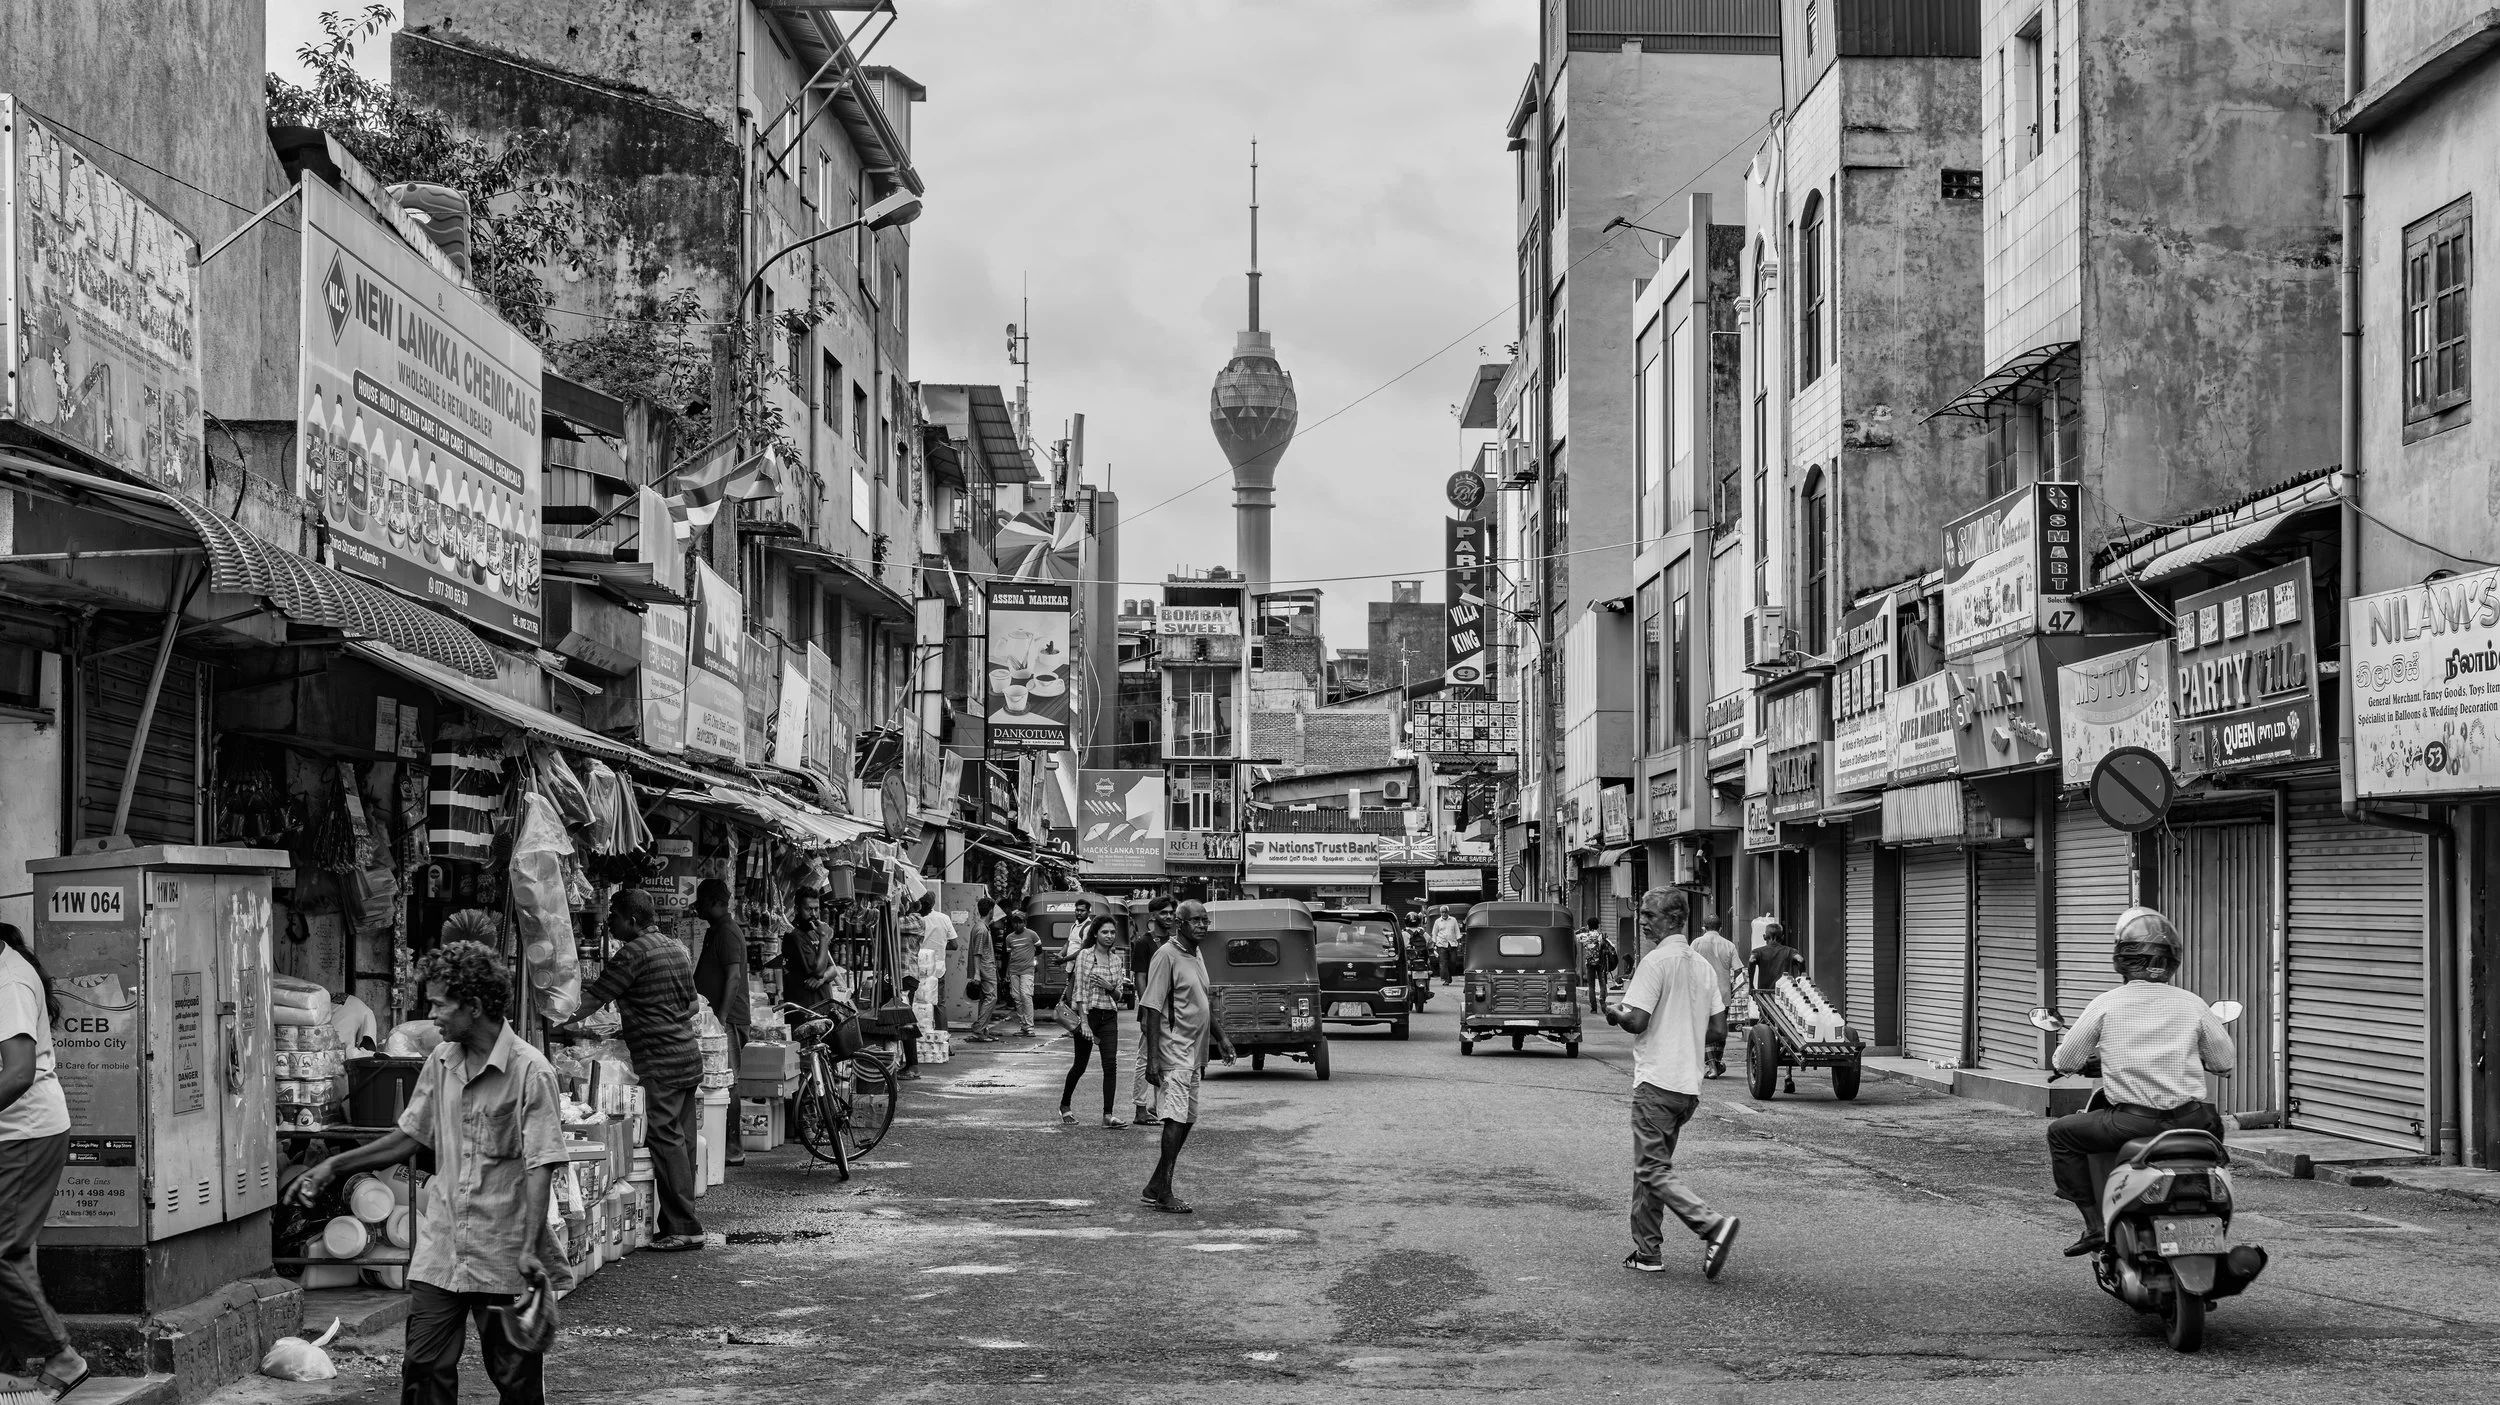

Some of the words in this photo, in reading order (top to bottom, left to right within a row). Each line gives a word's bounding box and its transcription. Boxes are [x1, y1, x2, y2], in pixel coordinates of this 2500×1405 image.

[329, 280, 345, 313] NLC
[356, 273, 393, 341] NEW
[398, 303, 459, 386] LANKKA
[464, 352, 535, 436] CHEMICALS
[398, 361, 440, 407] WHOLESALE
[441, 389, 446, 409] &
[448, 392, 468, 424] RETAIL
[469, 404, 492, 439] DEALER
[358, 378, 379, 404] HOUSE
[379, 391, 394, 414] HOLD
[400, 403, 419, 426] HEALTH
[421, 414, 434, 435] CARE
[439, 424, 449, 442] CAR
[450, 430, 464, 453] CARE
[468, 436, 495, 474] INDUSTRIAL
[496, 459, 521, 488] CHEMICALS
[2050, 487, 2056, 497] S
[2061, 499, 2067, 509] S
[1958, 509, 2000, 566] SMART
[2002, 517, 2030, 549] Selection
[1454, 526, 1477, 594] PARTY
[2048, 514, 2069, 590] SMART
[993, 594, 1024, 604] ASSENA
[1029, 595, 1068, 605] MARIKAR
[2048, 596, 2074, 604] Selecti
[1161, 609, 1233, 622] BOMBAY
[1450, 603, 1479, 627] VILLA
[2048, 610, 2076, 631] 47
[2368, 577, 2500, 647] NILAM'S
[1164, 623, 1226, 633] SWEET
[1850, 615, 1886, 656] SELECTION
[1451, 628, 1480, 654] KING
[2443, 640, 2500, 684] நிலாம்
[2074, 665, 2099, 705] MS
[2101, 654, 2150, 698] TOYS
[2178, 650, 2249, 716] PARTY
[2254, 642, 2305, 693] Villa
[2368, 696, 2391, 707] General
[2393, 691, 2422, 704] Merchant,
[2423, 689, 2442, 701] Fancy
[2444, 687, 2467, 698] Goods,
[2469, 684, 2484, 696] Toys
[2358, 712, 2386, 726] Specialist
[2388, 712, 2393, 721] in
[2395, 709, 2421, 721] Balloons
[2422, 708, 2428, 718] &
[2429, 705, 2458, 717] Wedding
[2460, 702, 2498, 715] Decoration
[994, 728, 1064, 739] DANKOTUWA
[1900, 718, 1919, 743] SAYED
[1920, 707, 1952, 738] MOHIDEE
[2224, 722, 2256, 755] QUEEN
[2257, 724, 2273, 744] (PVT)
[2274, 722, 2286, 738] LTD
[2428, 746, 2443, 767] 53
[1136, 847, 1160, 855] TRADE
[1170, 841, 1198, 851] RICH
[157, 882, 168, 902] 11W
[169, 881, 178, 902] 064
[646, 876, 674, 886] airtel
[52, 892, 85, 913] 11W
[91, 891, 120, 913] 064
[64, 1018, 110, 1033] CEB
[51, 1037, 100, 1048] Colombo
[104, 1037, 127, 1050] City
[66, 1062, 85, 1070] Care
[87, 1062, 99, 1070] for
[101, 1062, 129, 1070] mobile
[178, 1071, 199, 1081] DANGER
[67, 1176, 90, 1185] Care
[93, 1176, 111, 1185] lines
[55, 1189, 75, 1198] 011)
